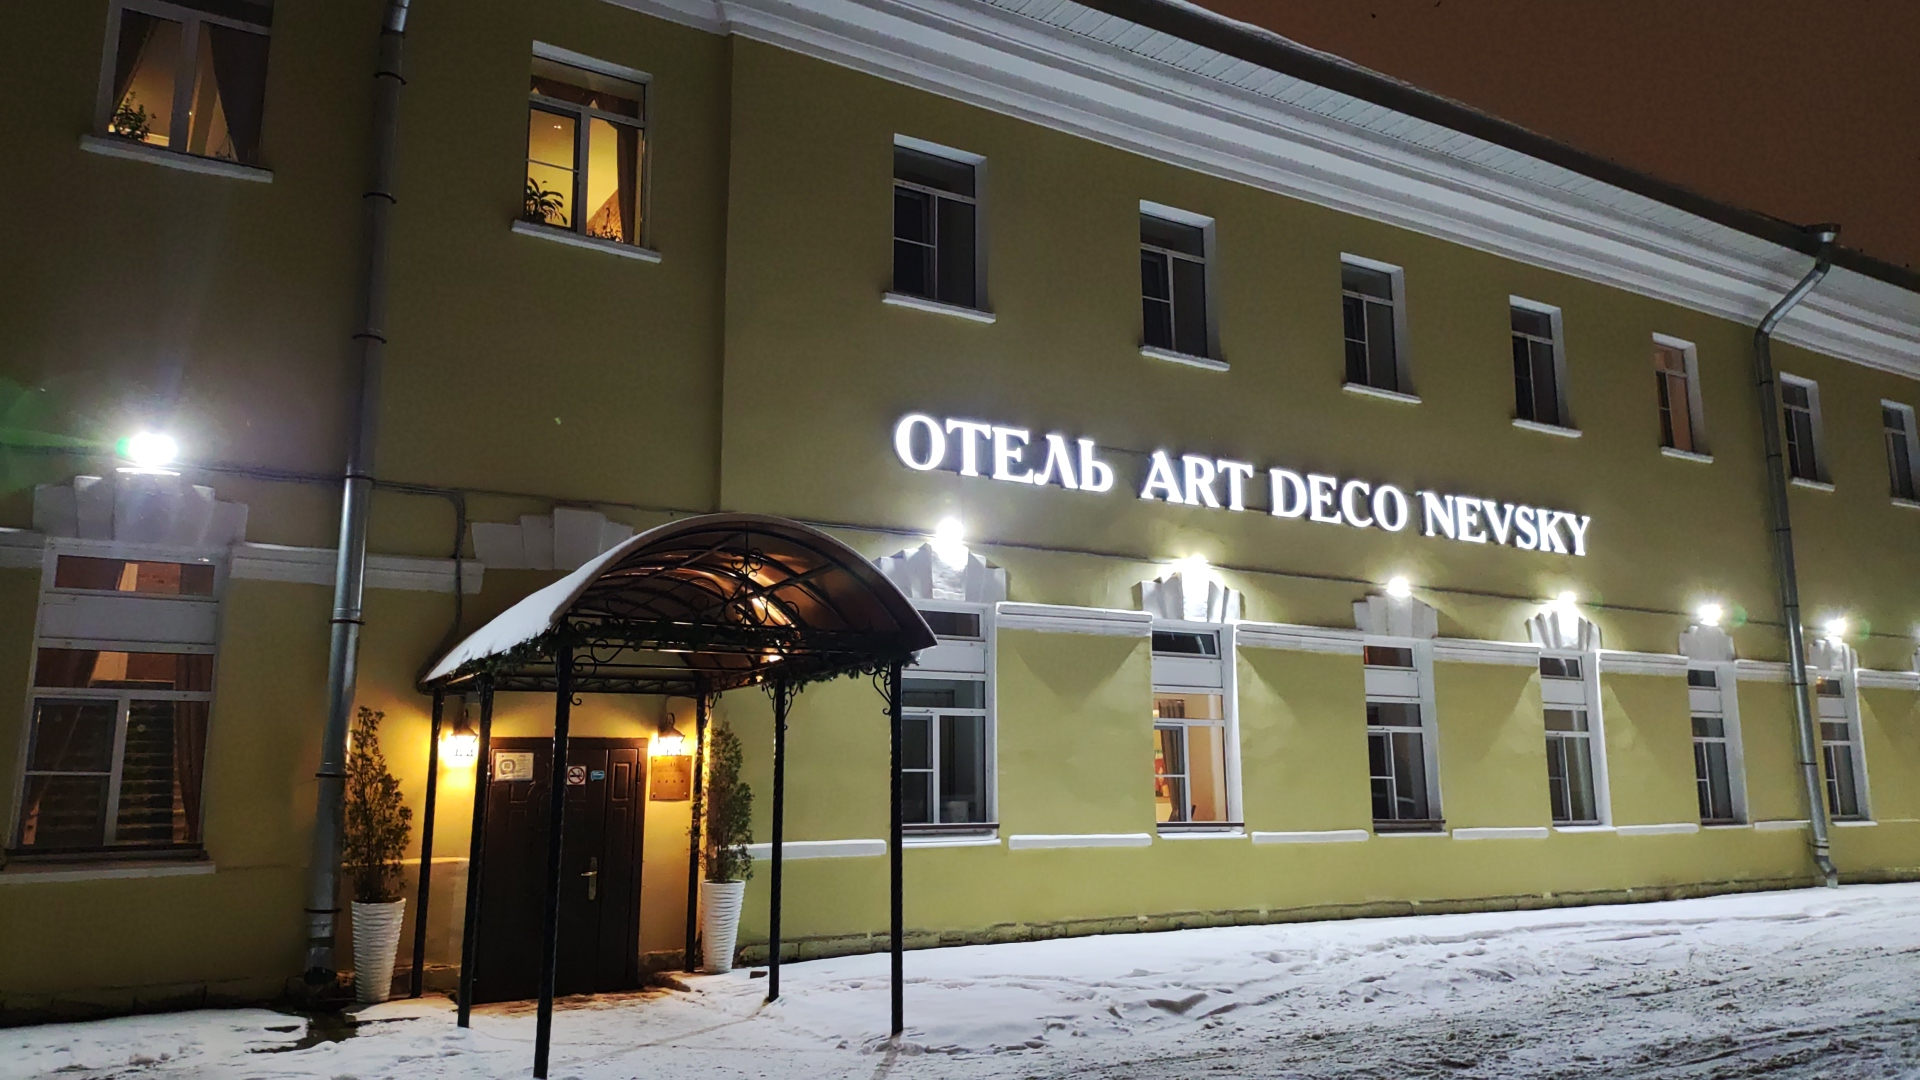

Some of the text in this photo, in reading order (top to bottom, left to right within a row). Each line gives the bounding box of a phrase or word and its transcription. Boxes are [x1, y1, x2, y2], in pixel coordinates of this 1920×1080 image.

[894, 413, 1592, 558] ОТЕЛЬ ART DECO NEVSKY
